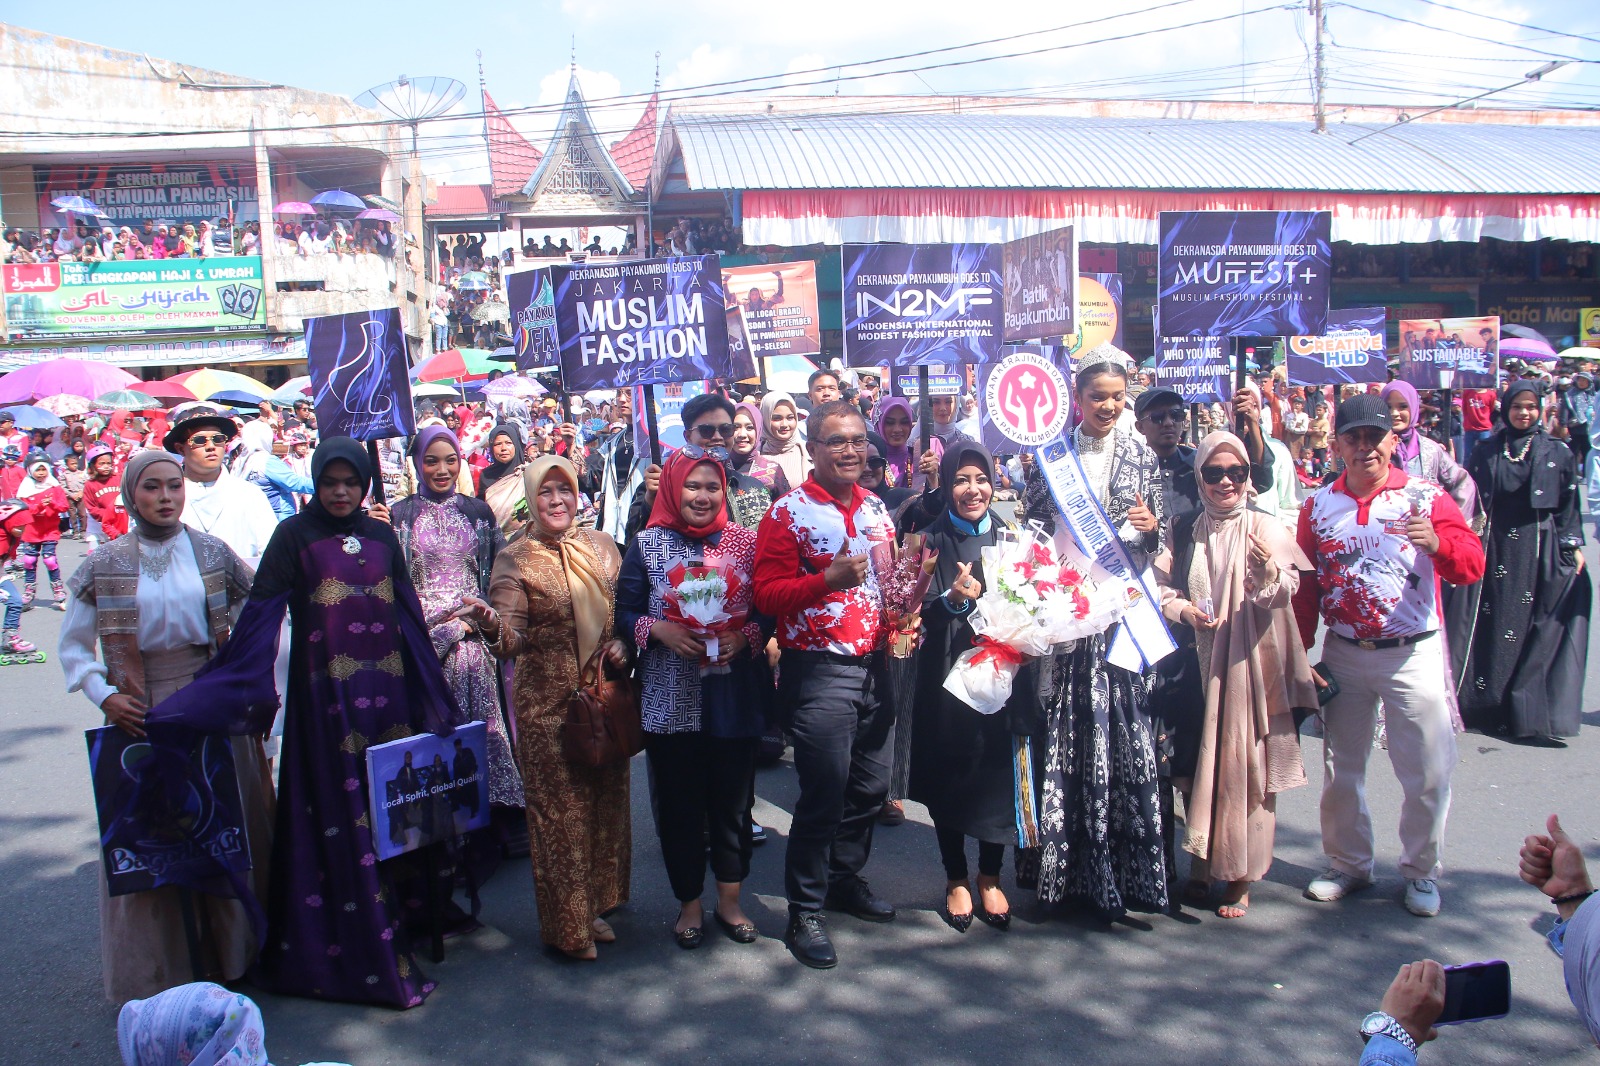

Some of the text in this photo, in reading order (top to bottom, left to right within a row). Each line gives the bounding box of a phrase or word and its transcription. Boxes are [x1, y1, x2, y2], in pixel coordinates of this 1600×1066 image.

[116, 172, 200, 186] SEKRETARIAT
[94, 188, 166, 204] PEMUDA
[135, 204, 220, 218] PAYAKUMBUH
[1174, 245, 1317, 256] DEKRANASDA PAYAKUMBUH GOES TO
[63, 264, 89, 274] Toko
[63, 266, 254, 284] PERLENGKAPAN HAJI & UMRAH
[569, 260, 702, 281] DEKRANASDA PAYAKUMBUH GOES TO
[574, 275, 702, 297] JAKARTA
[857, 272, 990, 286] DEKRANASDA PAYAKUMBUH GOES TO
[1023, 284, 1048, 304] Batik
[1172, 294, 1210, 302] MUSLIM
[1214, 293, 1256, 301] FASHION
[1260, 293, 1304, 301] FESTIVAL
[856, 287, 993, 318] IN2MF
[56, 316, 106, 324] SOUVENIR
[576, 293, 705, 334] MUSLIM
[757, 310, 777, 318] LOCAL
[779, 307, 801, 316] BRAND
[1005, 302, 1070, 331] Payakumbuh
[773, 317, 812, 328] SEPTEMBER
[857, 320, 994, 331] INDOENSIA INTERNATIONAL
[858, 329, 994, 341] MODEST FASHION FESTIVAL
[580, 326, 708, 366] FASHION
[1291, 335, 1382, 354] CREATIVE
[1164, 347, 1222, 360] WHO YOU ARE
[1326, 350, 1368, 366] Hub
[616, 365, 679, 382] WEEK
[1157, 364, 1230, 378] WITHOUT HAVING
[988, 355, 1067, 416] DEWAN KERAJINAN DAERAH
[1173, 382, 1216, 394] TO SPEAK.
[1000, 421, 1061, 442] PAYAKUMBUH
[1054, 464, 1076, 492] PUTRI
[1064, 488, 1089, 516] KOPI
[1076, 510, 1116, 564] INDONESIA
[381, 772, 484, 810] Local Spirit, Global Quality
